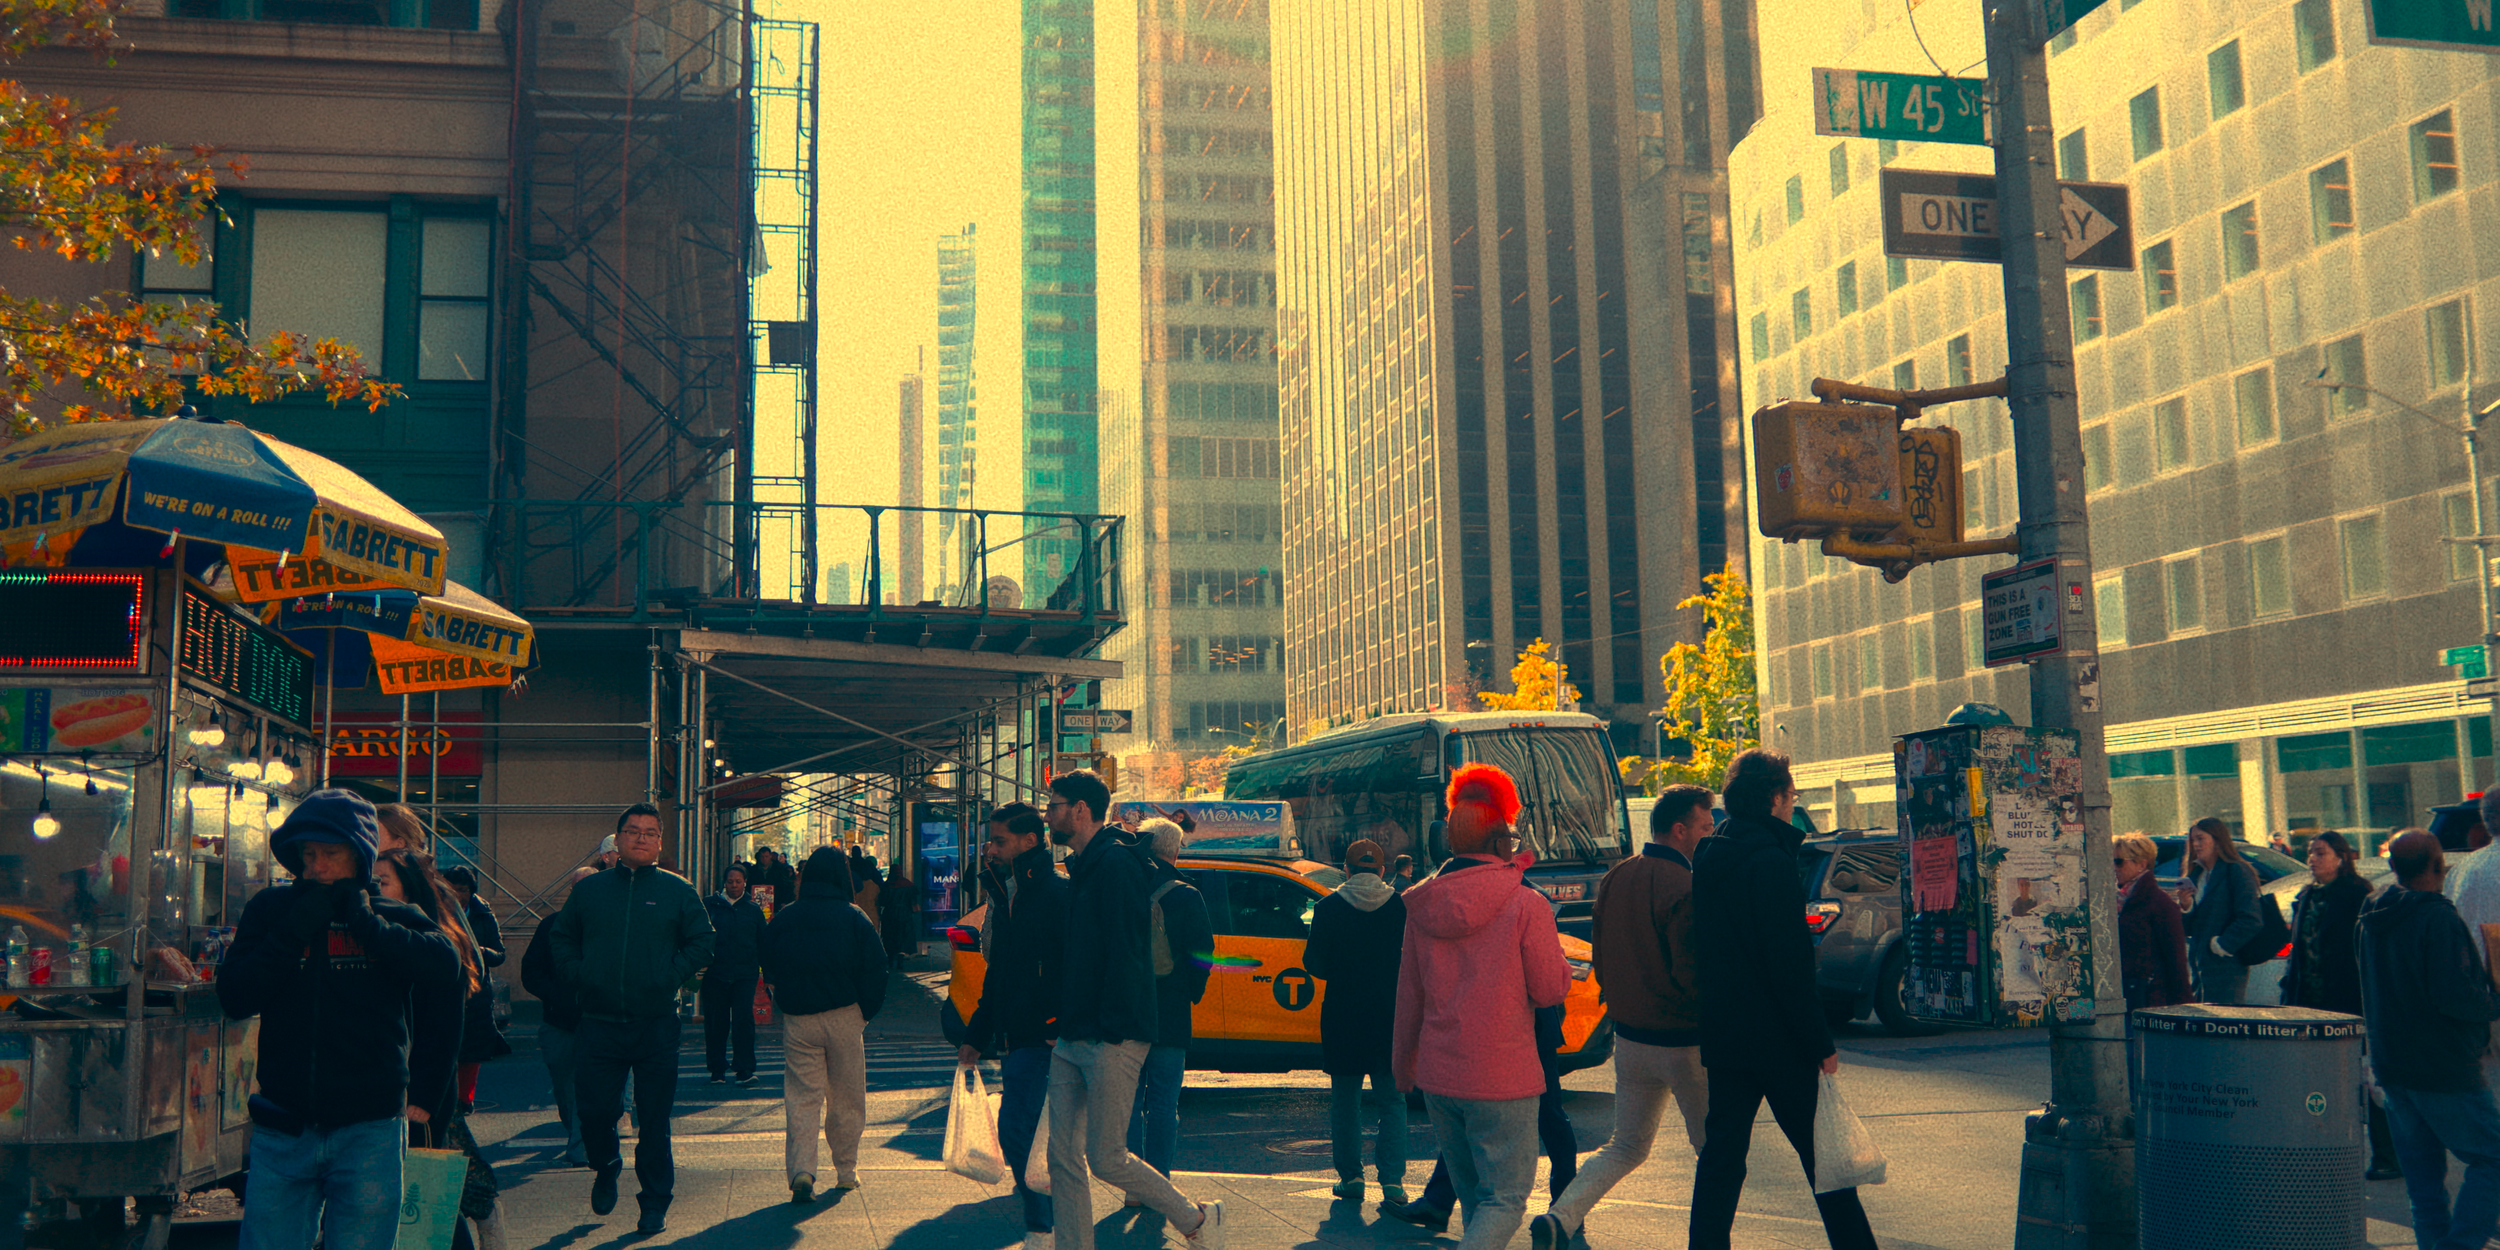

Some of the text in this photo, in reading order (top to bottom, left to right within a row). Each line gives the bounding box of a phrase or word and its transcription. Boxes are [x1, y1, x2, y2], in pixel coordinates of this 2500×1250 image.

[2466, 0, 2491, 31] W
[1861, 80, 1979, 133] W 45 St
[1921, 198, 2092, 240] ONE AY
[144, 491, 292, 531] WE'RE ON A ROLL !!!
[321, 512, 440, 579] SABRETT
[346, 602, 353, 610] A
[1987, 588, 2026, 608] THIS IS A
[1988, 603, 2031, 625] GUN FREE
[422, 607, 525, 656] SABRETT
[1988, 625, 2014, 642] ZONE
[180, 590, 302, 721] HOT DOG
[33, 691, 43, 720] HALAL
[1070, 716, 1121, 727] ONE WAY
[312, 729, 453, 758] ARGO
[1197, 807, 1278, 822] MOANA 2
[2008, 812, 2030, 820] BLU
[2007, 830, 2033, 838] SHUT
[1282, 976, 1306, 1005] T
[2149, 1018, 2177, 1031] litter
[2205, 1022, 2298, 1037] Don't litter
[2324, 1024, 2354, 1037] Don't
[2168, 1080, 2188, 1091] York
[2191, 1082, 2213, 1095] City
[2215, 1083, 2250, 1096] Clean
[2177, 1092, 2200, 1105] Your
[2203, 1095, 2228, 1107] New
[2231, 1096, 2260, 1109] York
[2187, 1105, 2236, 1120] Member
